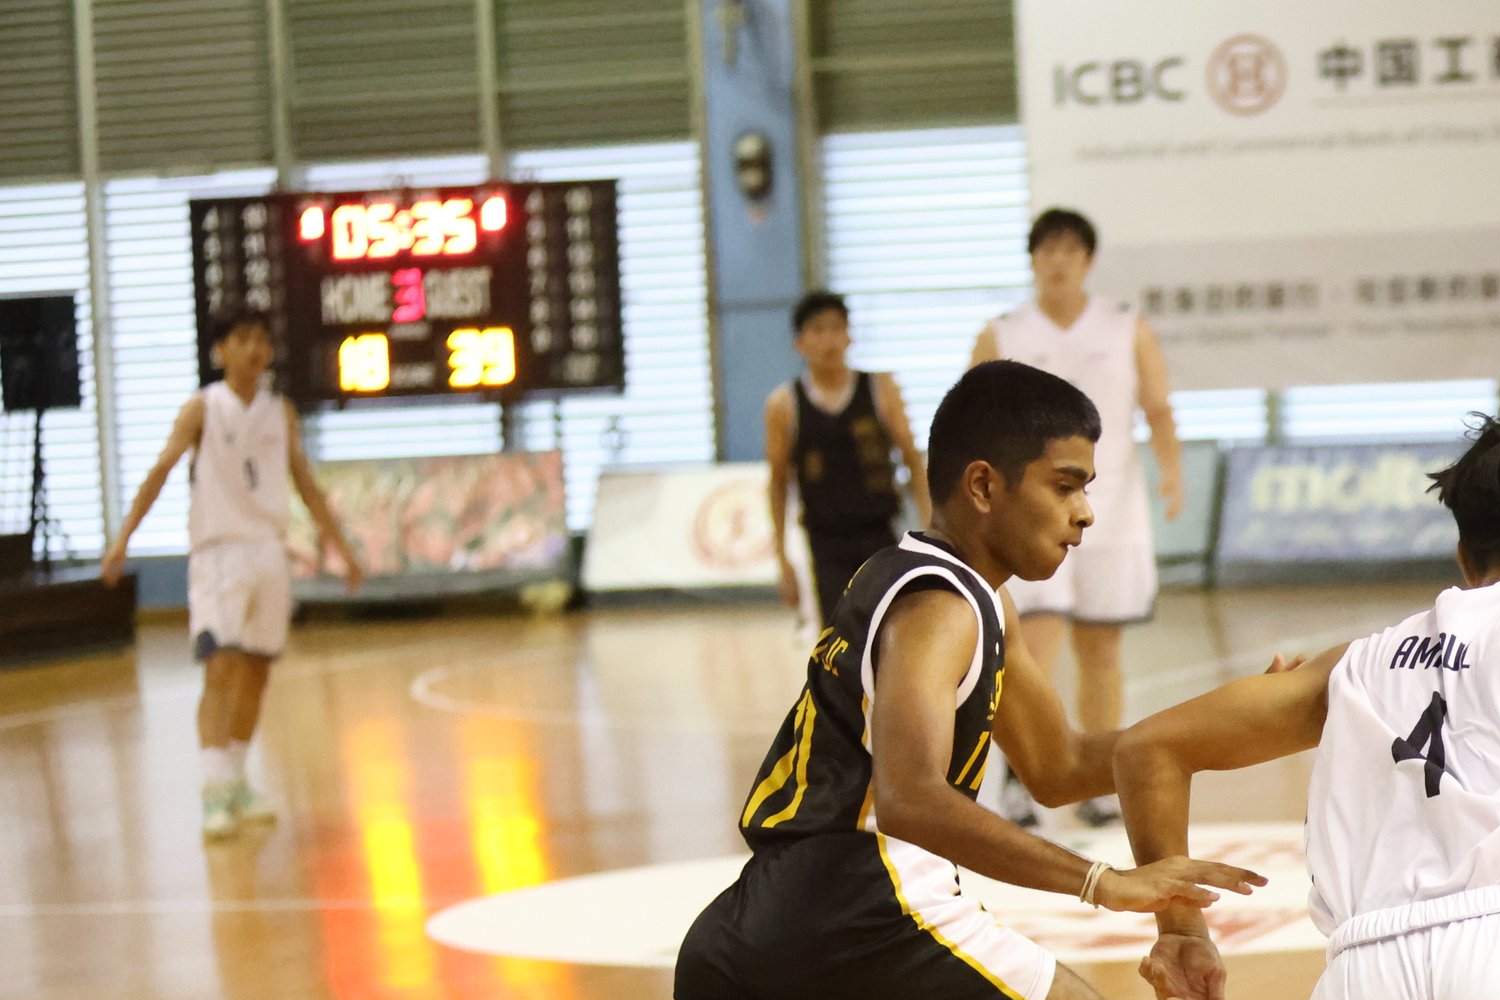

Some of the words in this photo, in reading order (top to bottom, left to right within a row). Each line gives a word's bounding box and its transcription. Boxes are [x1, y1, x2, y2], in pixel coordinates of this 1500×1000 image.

[1051, 55, 1187, 109] ICBC
[332, 198, 477, 260] 05:35
[391, 267, 426, 323] 3
[446, 326, 516, 388] 39
[1391, 690, 1448, 798] 4
